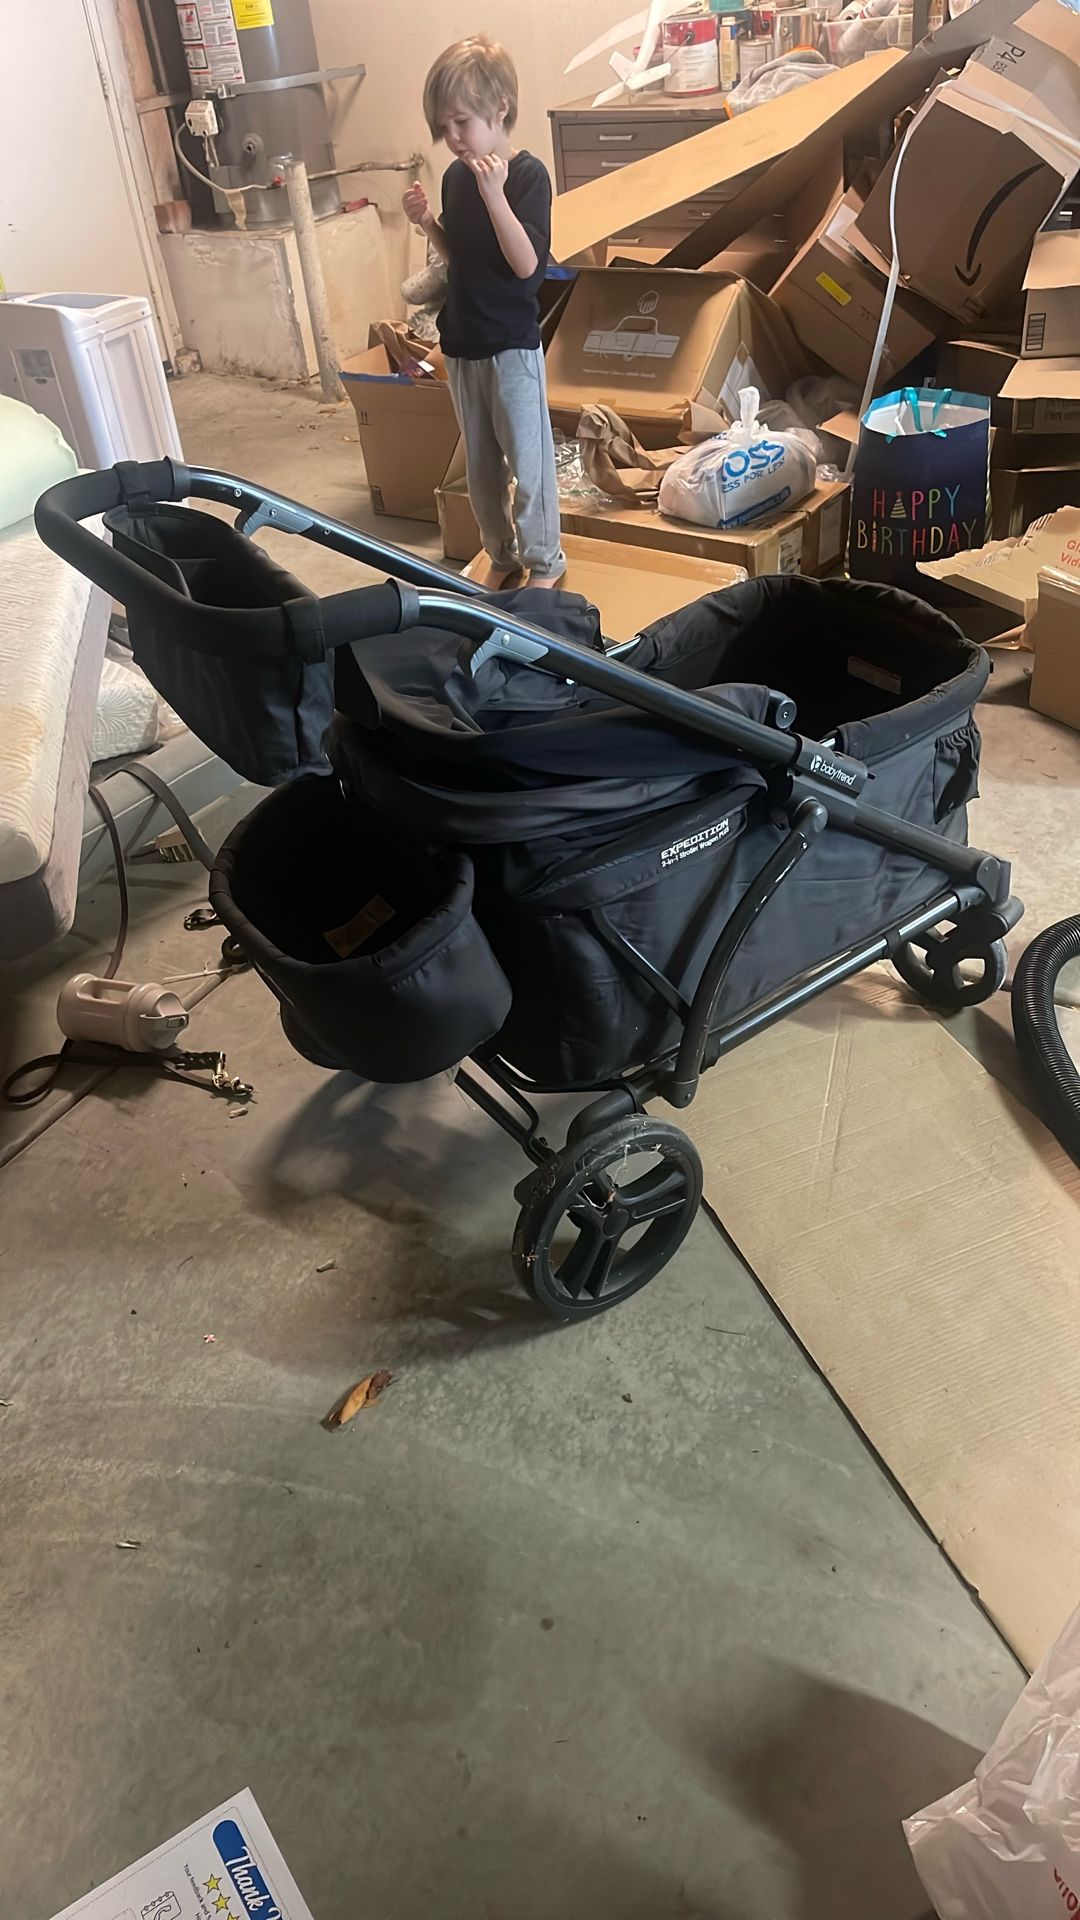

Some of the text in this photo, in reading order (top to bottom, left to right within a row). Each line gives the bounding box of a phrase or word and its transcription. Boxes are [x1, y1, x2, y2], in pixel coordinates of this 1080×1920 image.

[744, 470, 763, 483] FOR
[872, 484, 960, 520] HAPPY
[820, 760, 857, 785] babytrend
[661, 818, 729, 860] EXPEDITION
[699, 835, 719, 849] Wagon
[226, 1846, 270, 1910] Thank
